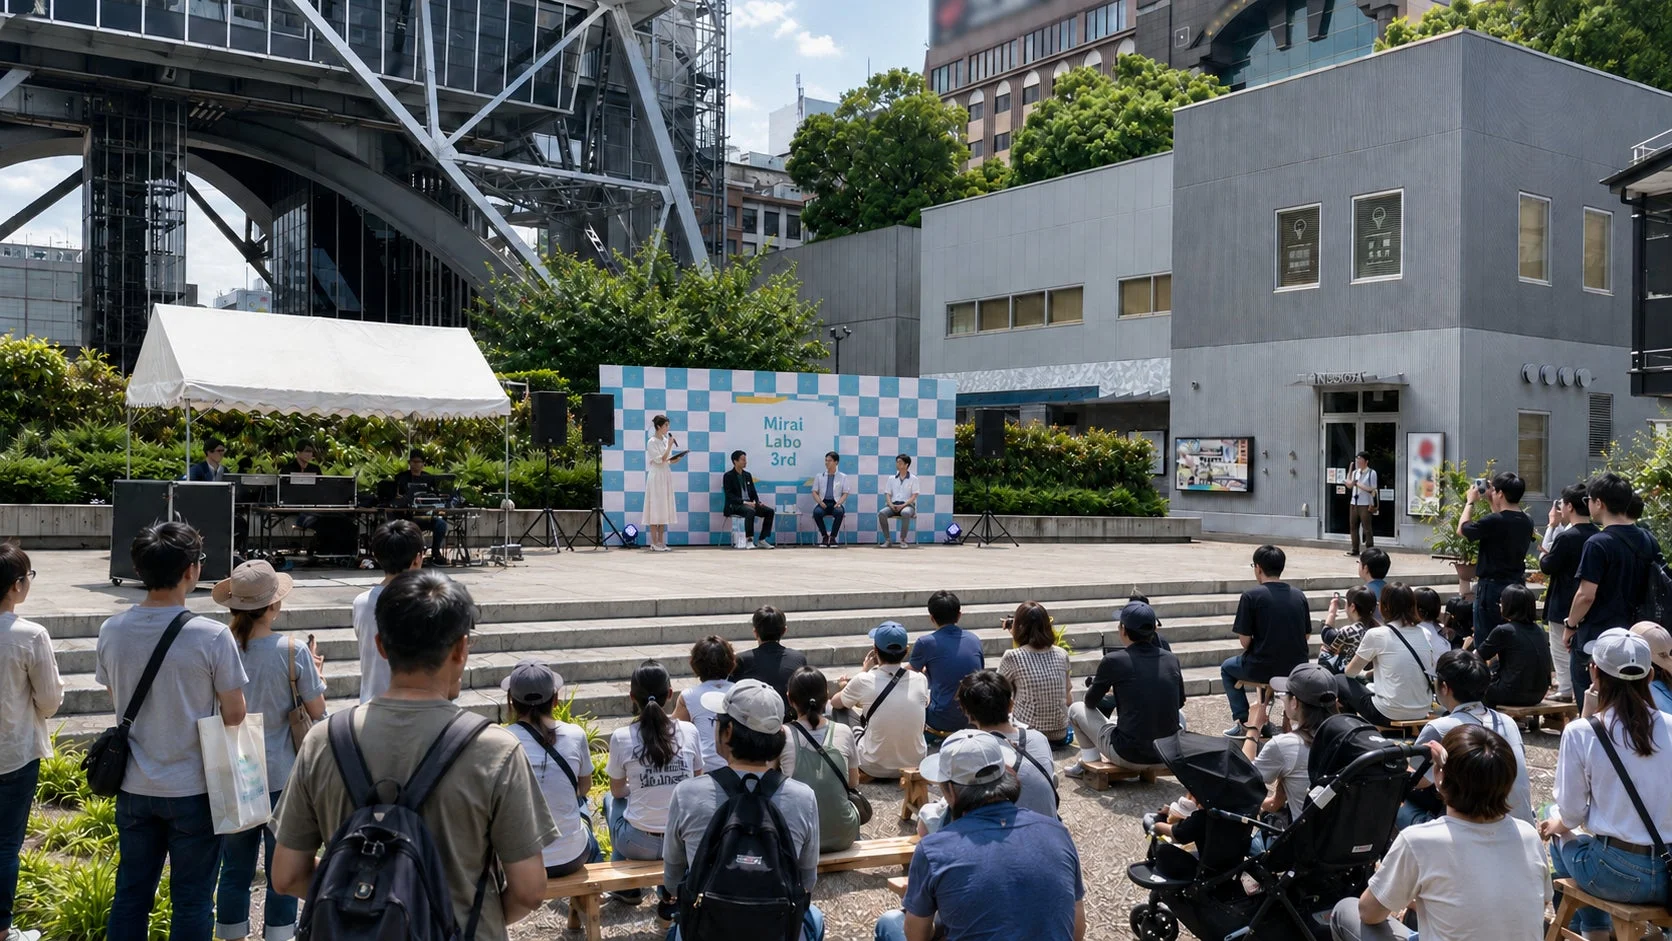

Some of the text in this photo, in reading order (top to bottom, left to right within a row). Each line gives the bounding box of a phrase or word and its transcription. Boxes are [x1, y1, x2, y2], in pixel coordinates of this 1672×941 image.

[764, 416, 803, 431] Mirai
[765, 433, 802, 448] Labo
[771, 451, 796, 466] 3rd
